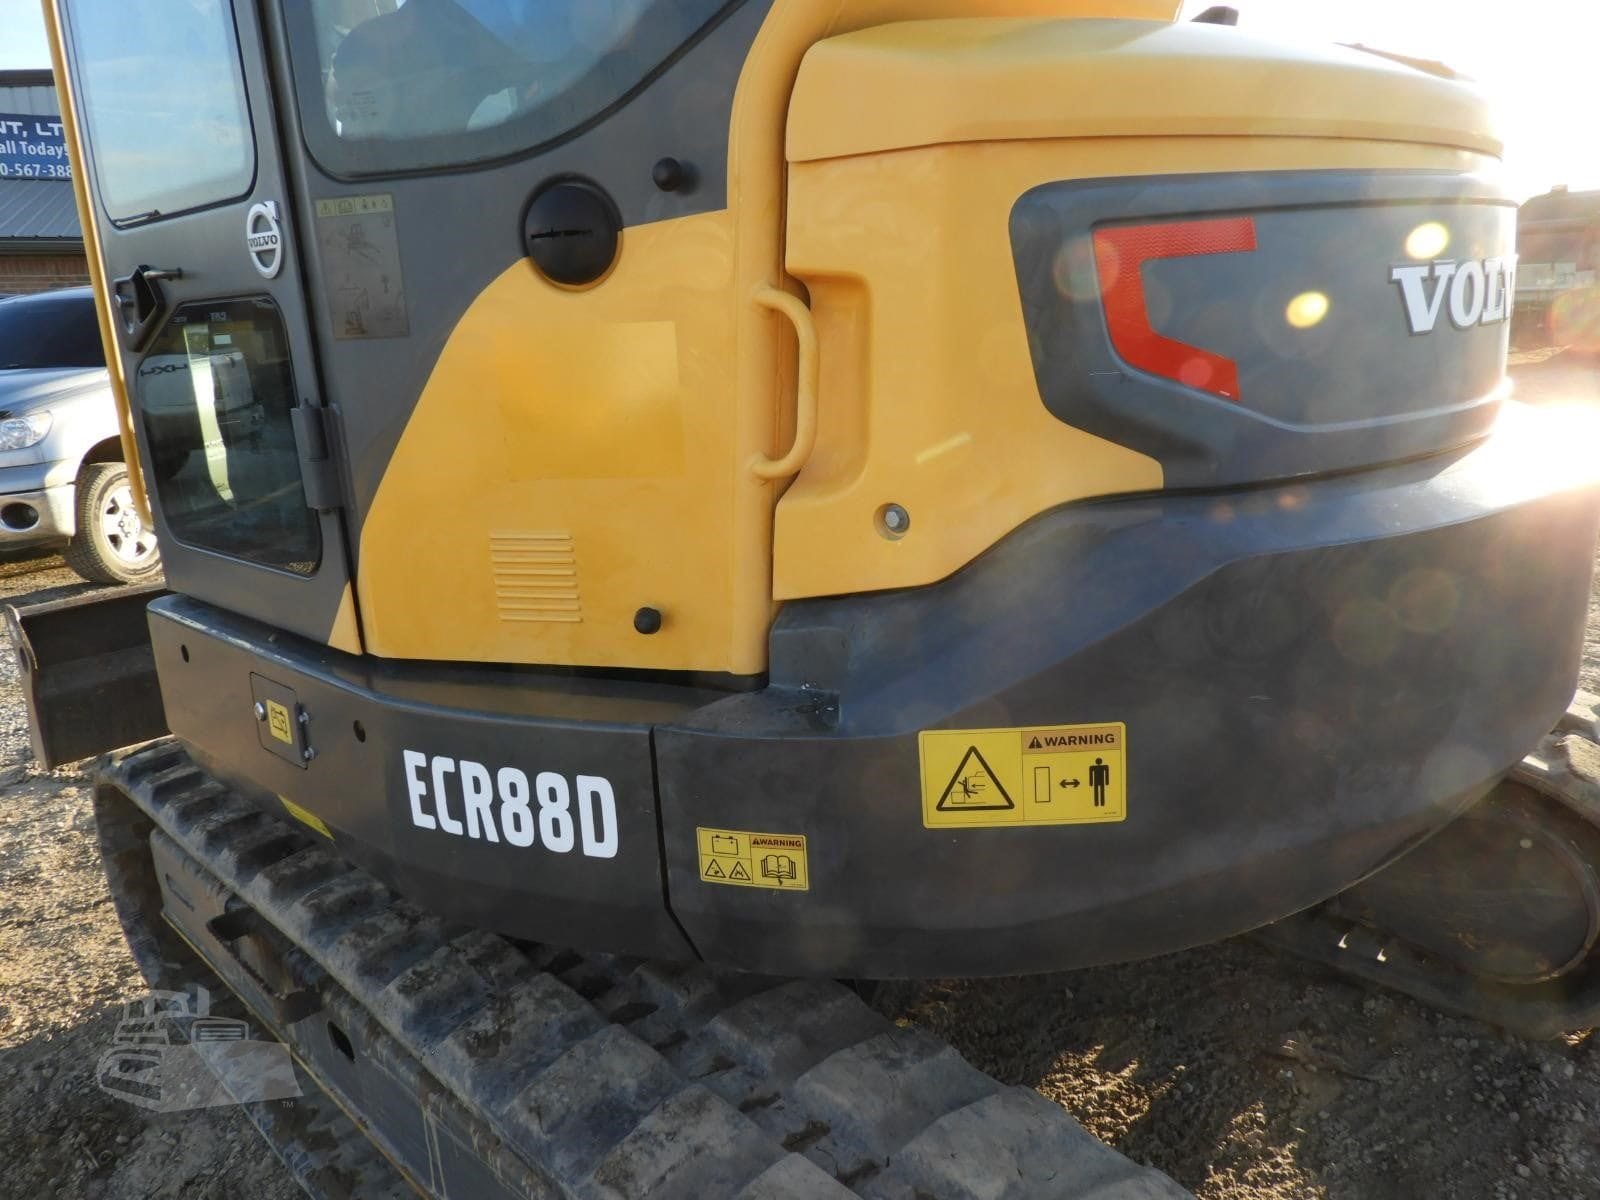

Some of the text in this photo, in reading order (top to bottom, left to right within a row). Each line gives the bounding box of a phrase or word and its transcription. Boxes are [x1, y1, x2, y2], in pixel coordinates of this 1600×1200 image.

[18, 141, 68, 160] Today!
[248, 234, 278, 248] VOLVO
[1044, 733, 1116, 747] WARNING
[403, 749, 619, 859] ECR88D
[759, 838, 802, 848] WARNING
